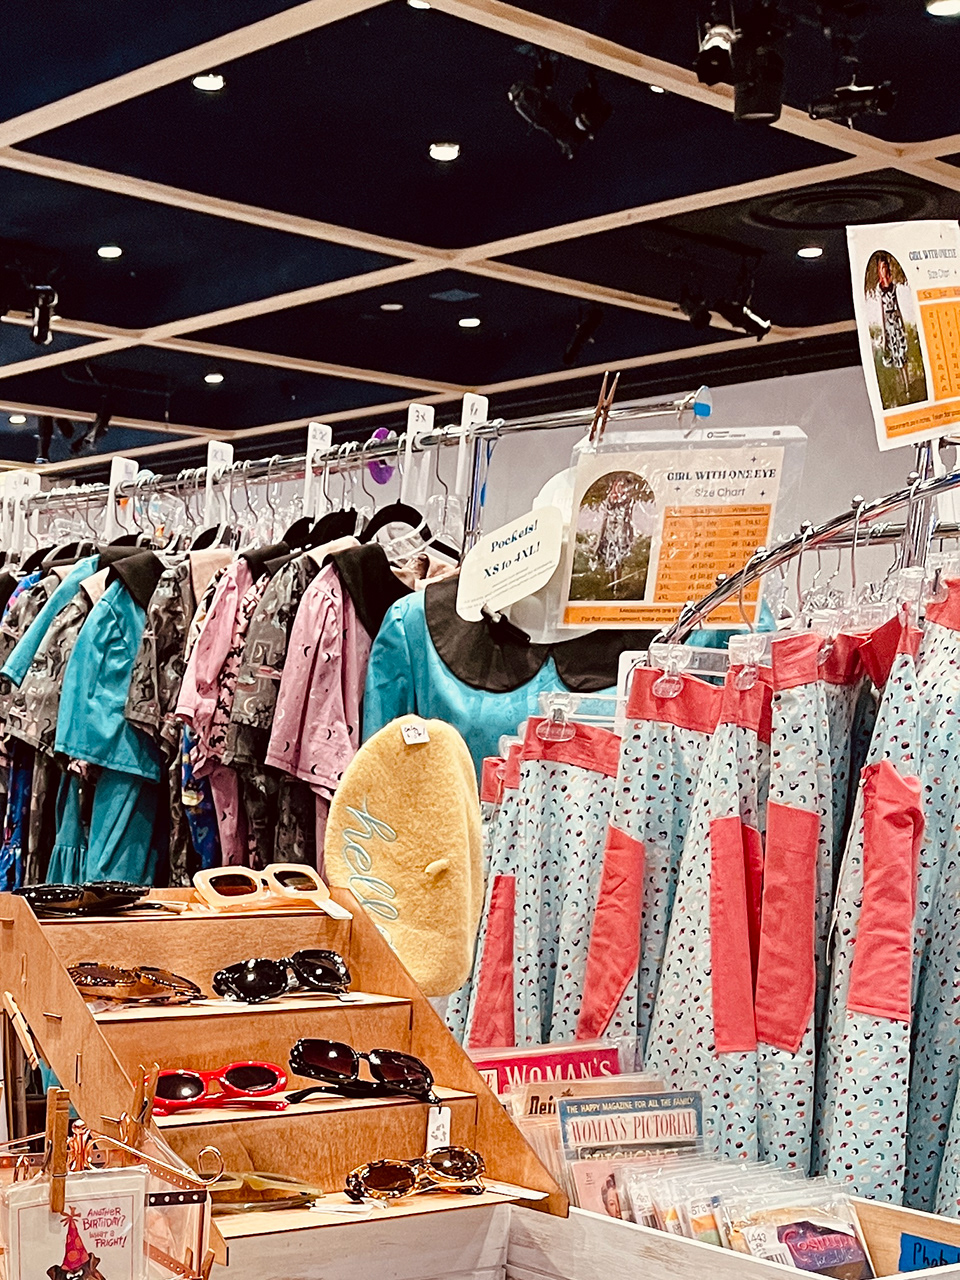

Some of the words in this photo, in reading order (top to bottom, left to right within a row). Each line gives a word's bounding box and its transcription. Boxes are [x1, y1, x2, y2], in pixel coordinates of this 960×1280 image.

[667, 471, 692, 481] GIRL
[695, 470, 728, 480] WITH
[754, 468, 776, 479] EYE
[694, 487, 716, 498] Size
[717, 487, 745, 497] Chart
[491, 519, 538, 552] Pockets!
[484, 563, 499, 579] XS
[514, 541, 540, 562] 4XL!
[505, 1057, 613, 1084] WOMAN'S
[566, 1105, 578, 1113] THE
[580, 1104, 600, 1112] HAPPY
[602, 1101, 633, 1111] MAGAZINE
[634, 1100, 647, 1109] FOR
[648, 1099, 659, 1108] ALL
[661, 1098, 672, 1107] THE
[571, 1115, 628, 1144] WOMAN'S
[633, 1111, 695, 1140] PICTORIAL
[82, 1215, 126, 1231] BIRTHDAY?
[95, 1236, 127, 1248] FRIGHT!
